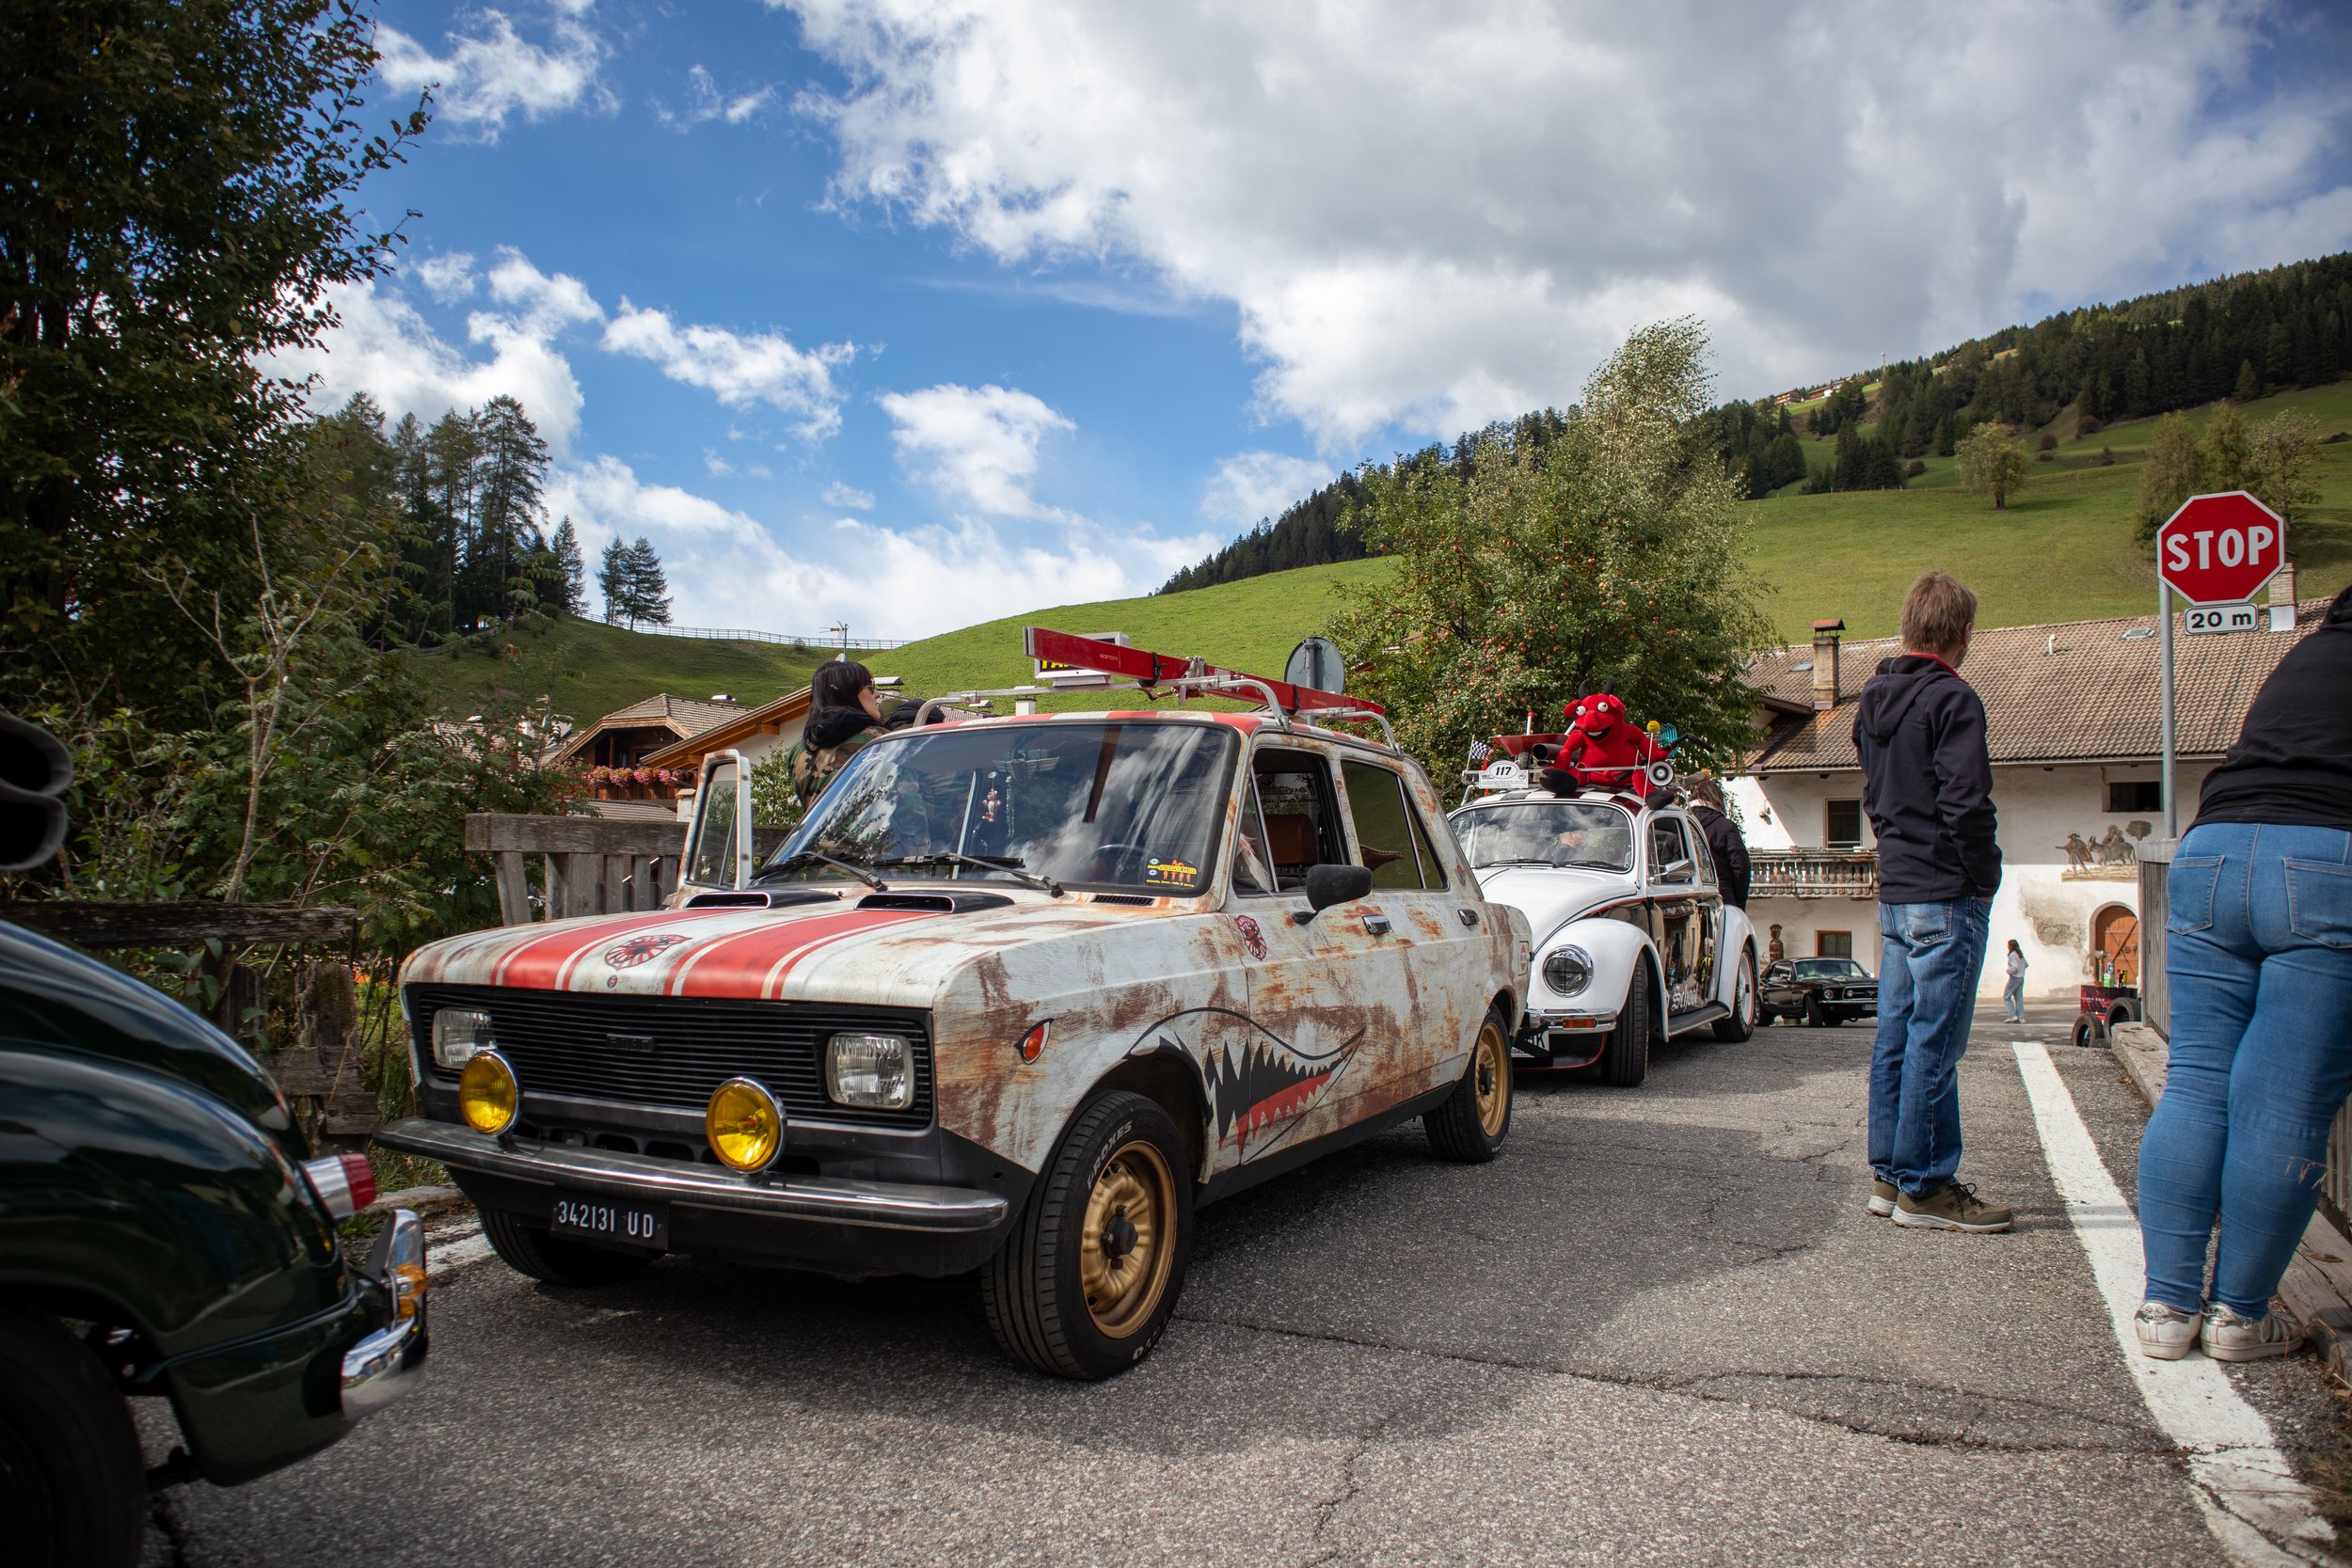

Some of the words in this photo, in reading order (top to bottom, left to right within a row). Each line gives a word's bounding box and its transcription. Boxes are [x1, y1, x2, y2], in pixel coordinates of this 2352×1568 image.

[2167, 525, 2274, 572] STOP
[2191, 611, 2222, 628] 20
[2232, 612, 2251, 626] m
[1496, 767, 1512, 776] 117
[1087, 1119, 1134, 1191] PROXES
[558, 1201, 615, 1232] 342131
[628, 1212, 654, 1238] UD
